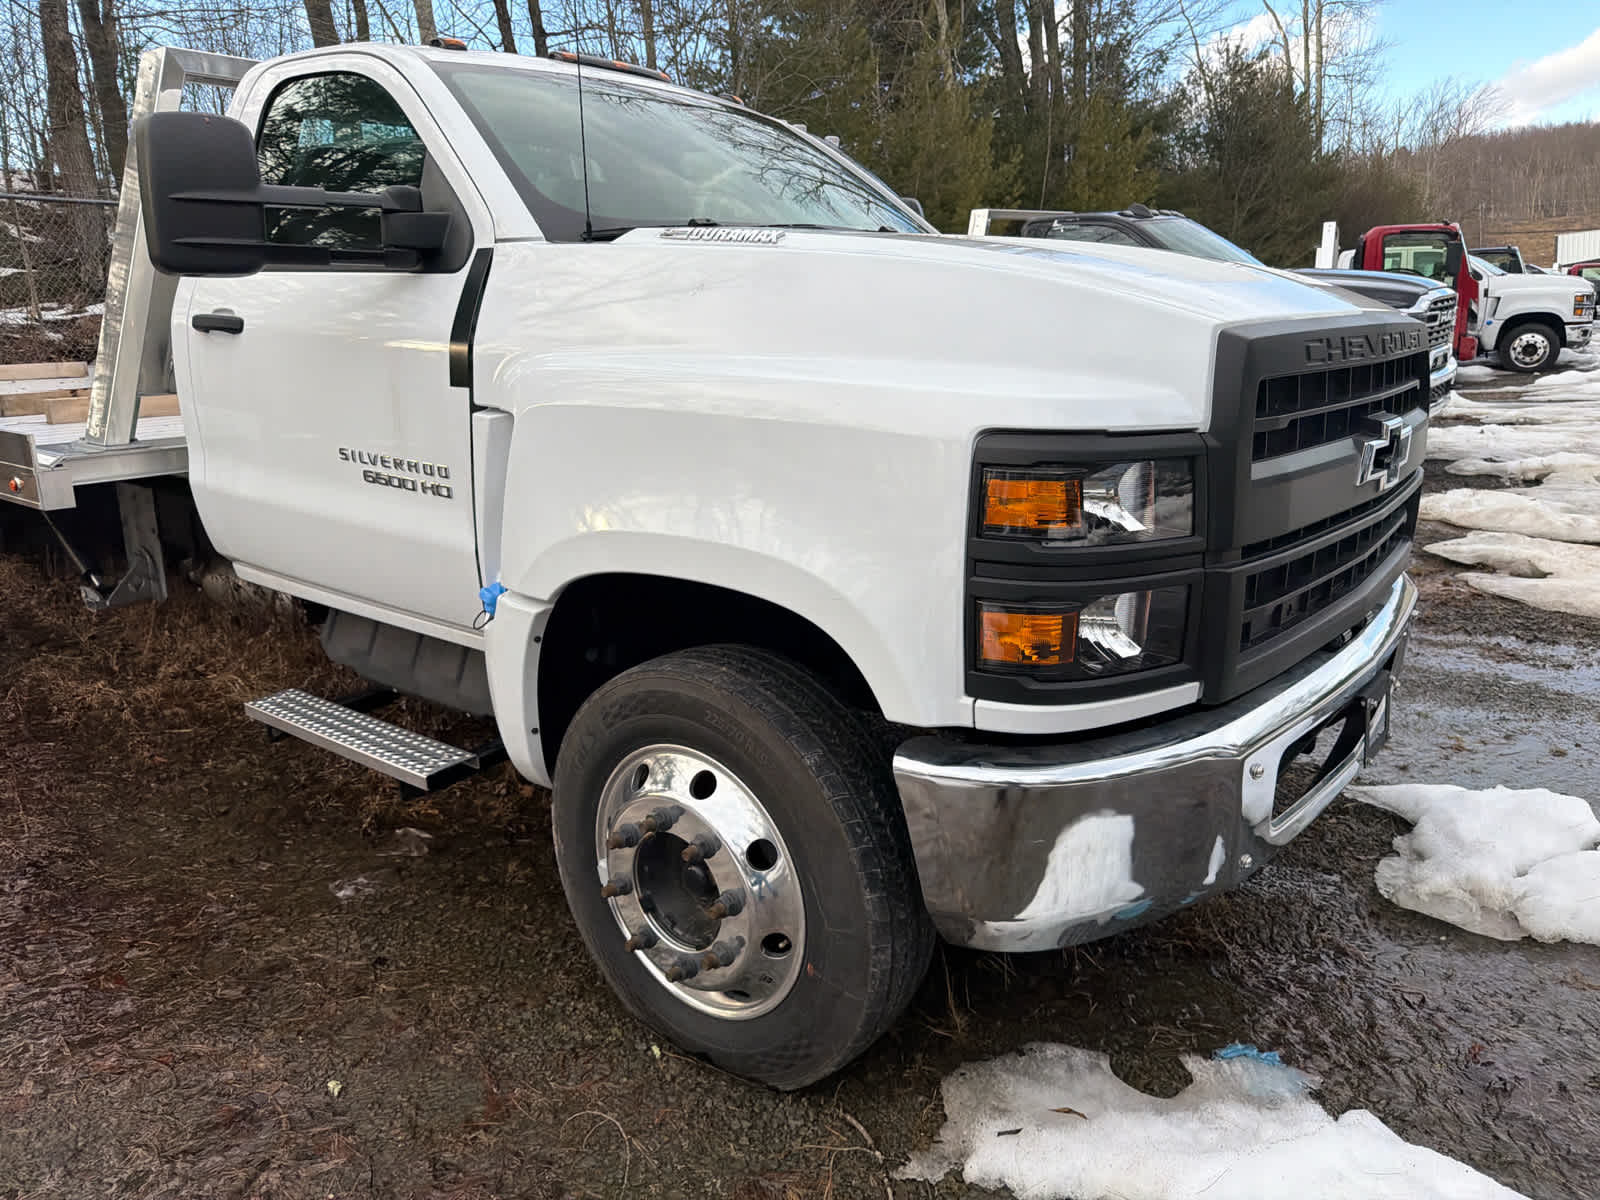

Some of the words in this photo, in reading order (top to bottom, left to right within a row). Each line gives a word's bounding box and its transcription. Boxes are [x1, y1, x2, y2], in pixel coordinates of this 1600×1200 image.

[685, 227, 786, 245] DURAMAX
[1304, 328, 1422, 366] CHEVROLET
[338, 447, 451, 480] SILVERADO
[362, 469, 419, 493] 6500
[420, 480, 454, 500] HD
